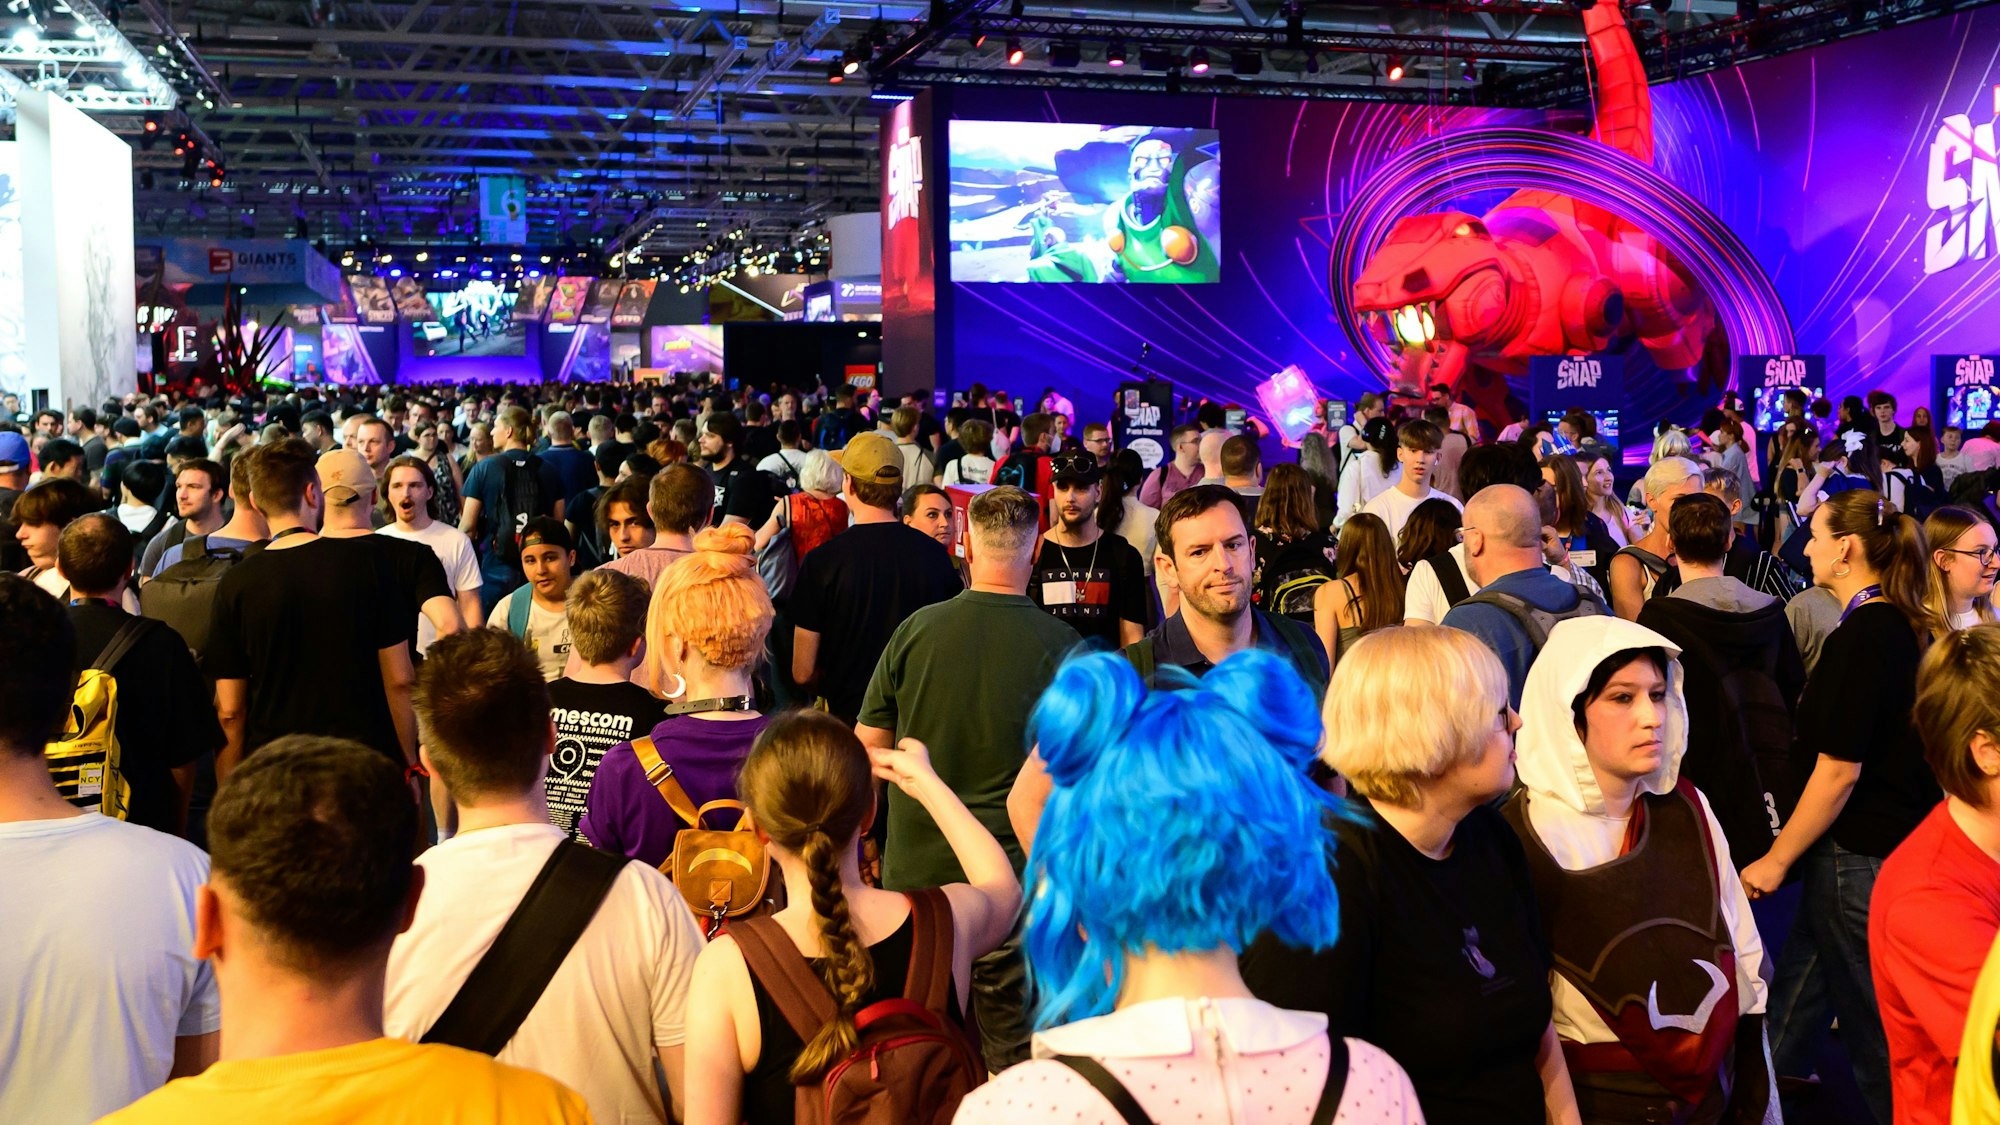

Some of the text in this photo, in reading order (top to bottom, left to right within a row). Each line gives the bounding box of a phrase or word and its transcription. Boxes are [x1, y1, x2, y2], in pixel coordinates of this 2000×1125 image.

[238, 252, 297, 265] GIANTS
[848, 376, 873, 388] LEGO
[1557, 360, 1602, 389] SNAP
[1765, 359, 1806, 387] SNAP
[1955, 358, 1994, 386] SNAP
[559, 724, 631, 739] 2023 EXPERIENCE
